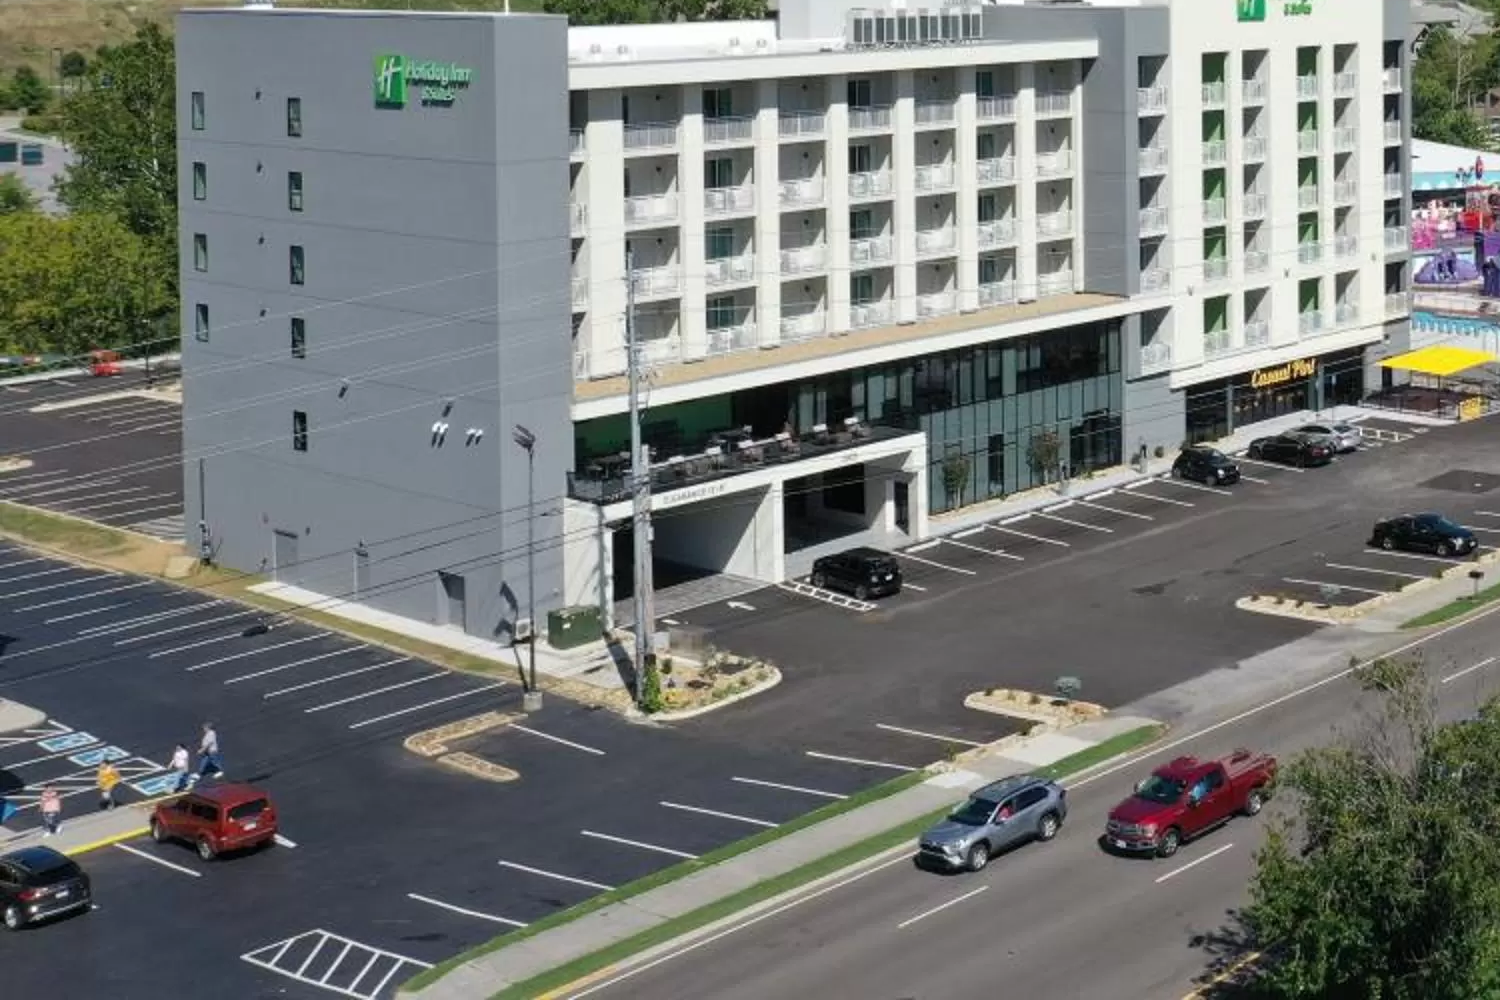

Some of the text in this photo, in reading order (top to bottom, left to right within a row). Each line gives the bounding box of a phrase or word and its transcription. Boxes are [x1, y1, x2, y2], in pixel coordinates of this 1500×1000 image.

[406, 60, 472, 85] Holiday Inn
[1251, 363, 1291, 388] Casual
